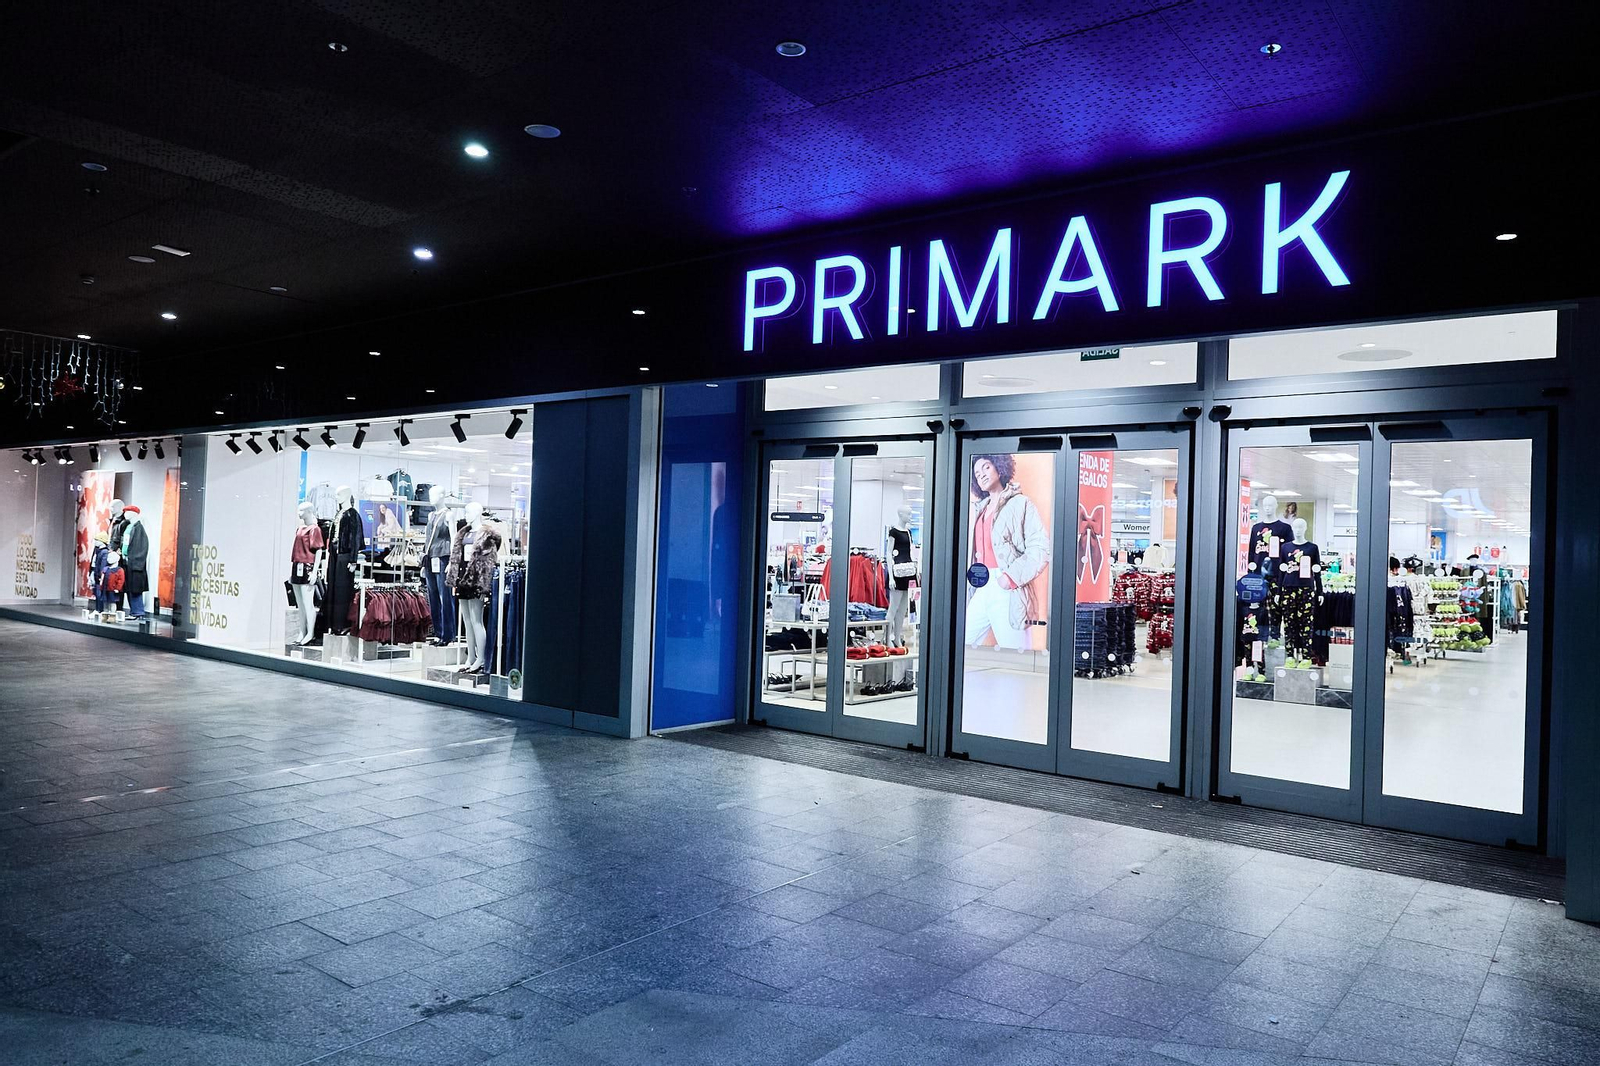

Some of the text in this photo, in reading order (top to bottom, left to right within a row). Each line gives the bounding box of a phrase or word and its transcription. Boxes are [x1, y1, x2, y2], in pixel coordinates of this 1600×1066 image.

[743, 170, 1352, 352] PRIMARK
[1099, 457, 1110, 473] DE
[17, 547, 37, 559] LO QUE
[191, 544, 218, 560] TODO
[16, 559, 45, 574] NECESITAS
[191, 560, 225, 578] LO QUE
[15, 572, 29, 583] ESTA
[15, 585, 38, 598] NAVIDAD
[190, 577, 240, 597] NECESITAS
[190, 593, 212, 610] ESTA
[189, 609, 228, 629] NAVIDAD
